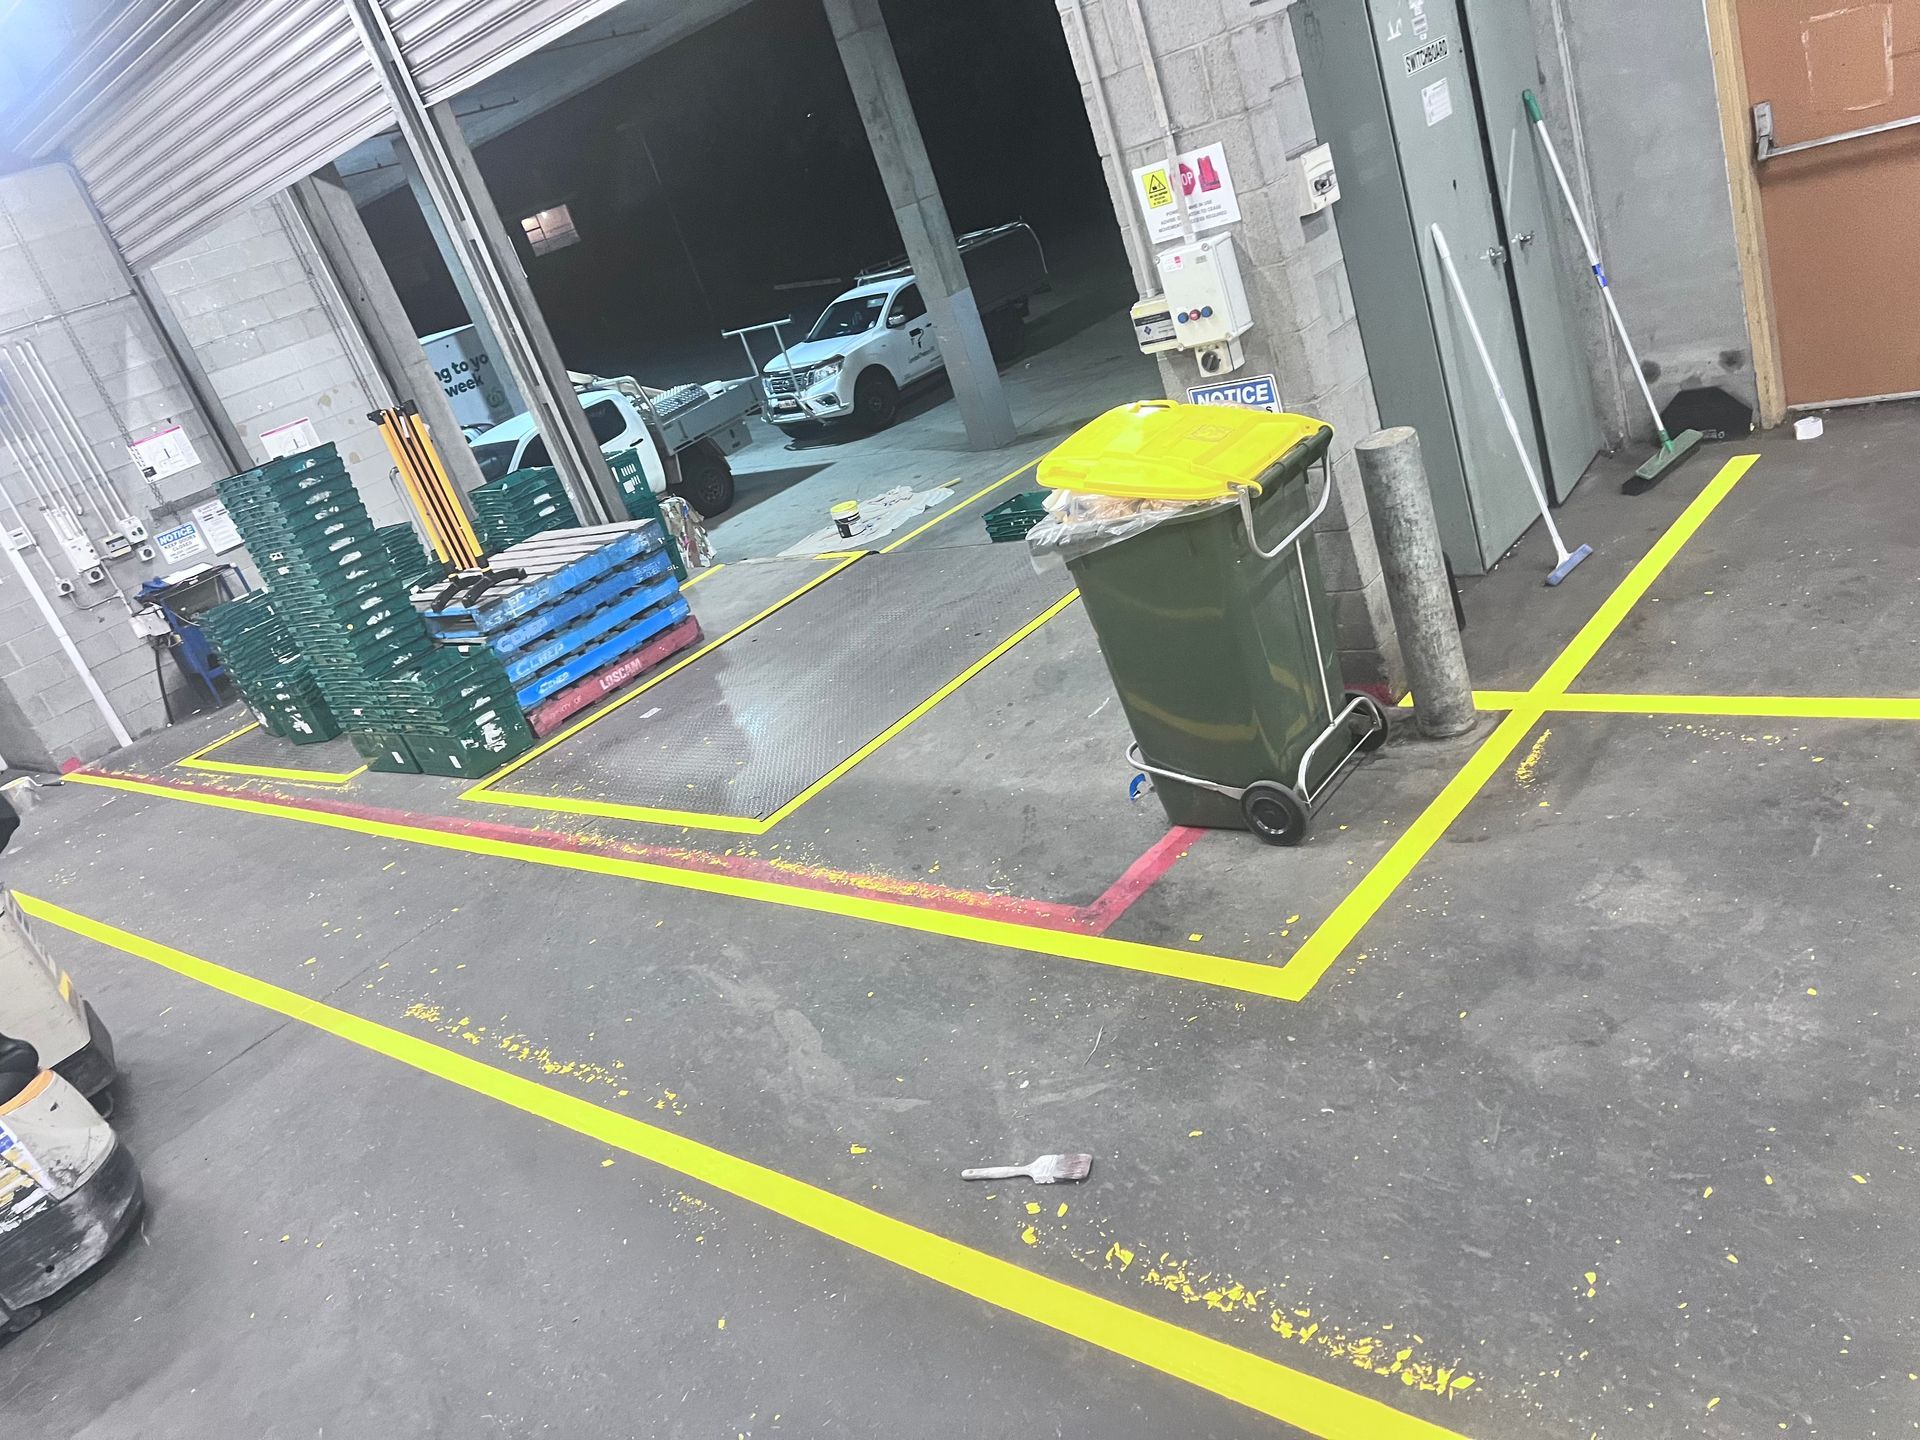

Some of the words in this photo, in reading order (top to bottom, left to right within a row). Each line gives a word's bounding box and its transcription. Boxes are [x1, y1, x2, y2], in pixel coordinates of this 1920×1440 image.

[1405, 39, 1448, 72] SWITCHBOARD
[1181, 171, 1193, 186] OP
[451, 361, 469, 375] to
[469, 354, 489, 372] yo
[444, 373, 484, 397] week
[159, 525, 195, 546] NOTICE
[599, 657, 643, 691] LOSCAM
